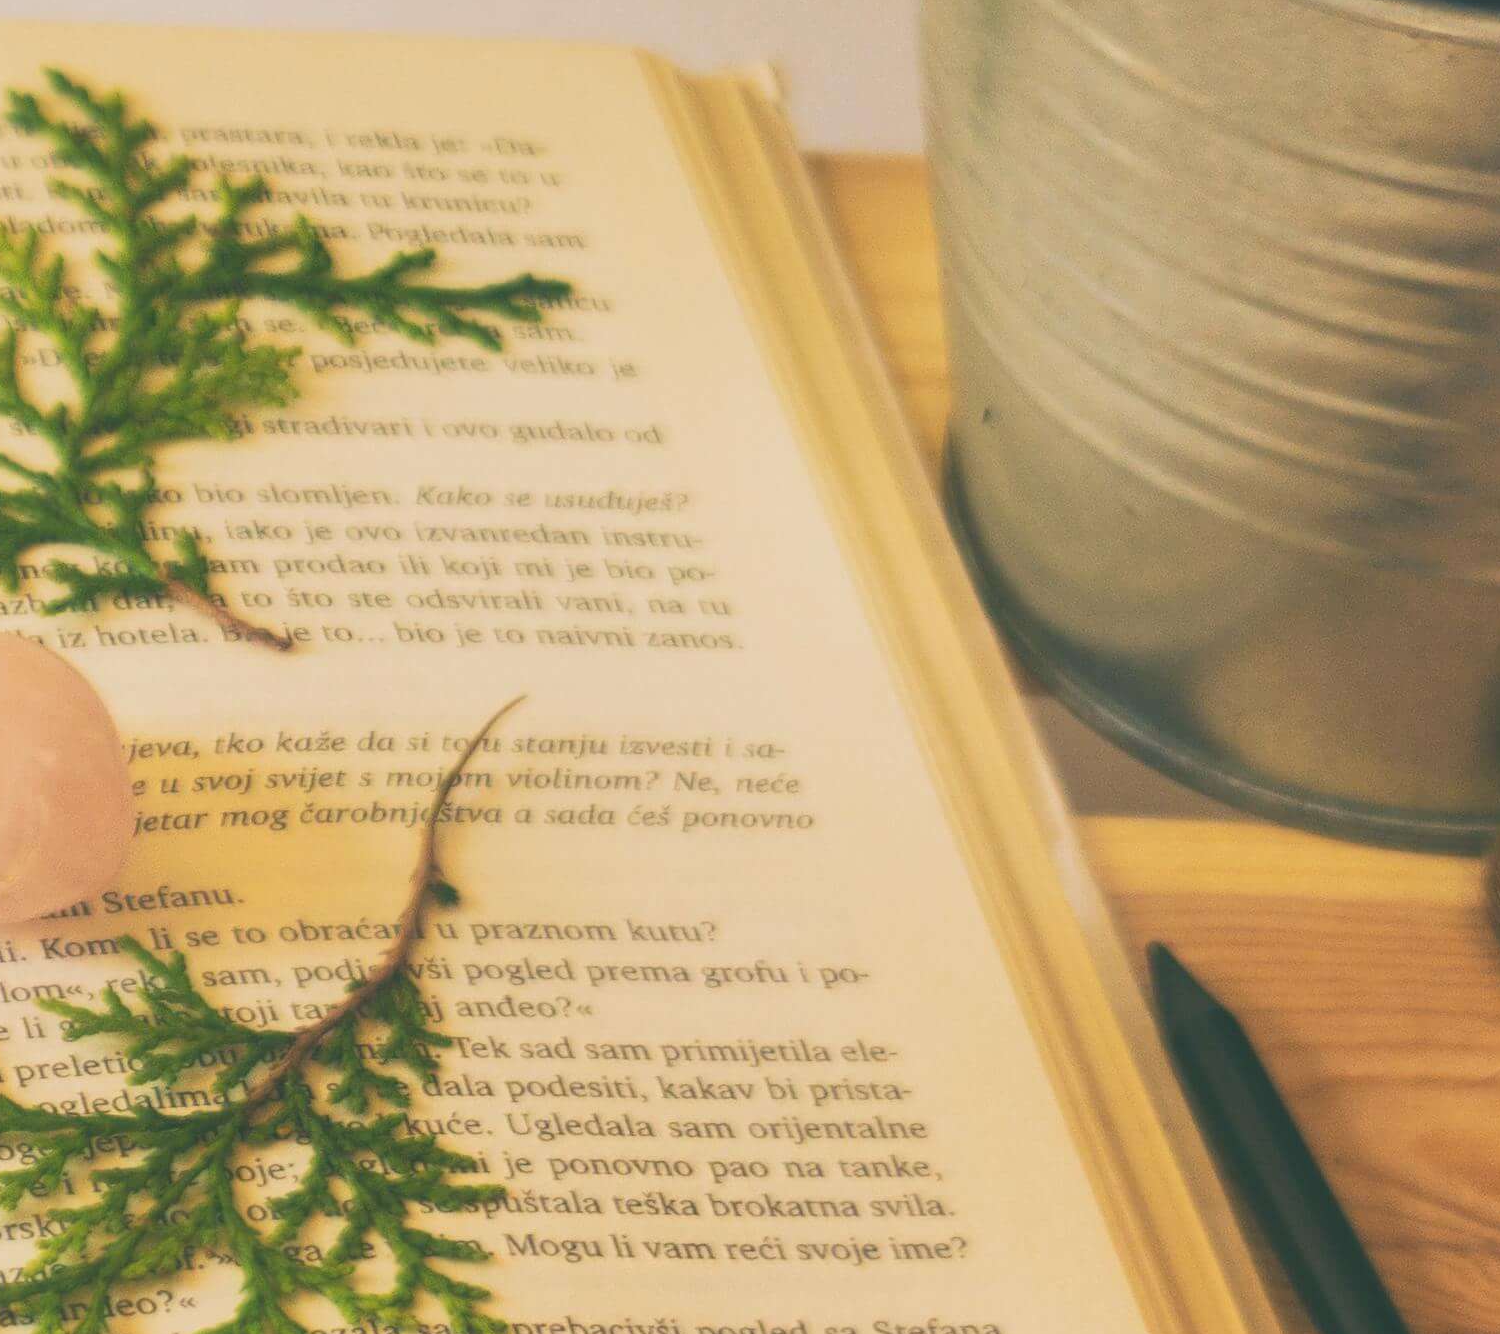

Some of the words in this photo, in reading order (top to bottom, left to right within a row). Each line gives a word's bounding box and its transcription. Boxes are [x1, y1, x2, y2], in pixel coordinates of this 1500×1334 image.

[193, 484, 246, 503] bio
[257, 484, 400, 509] slomljen.
[416, 485, 494, 507] Kako
[502, 490, 533, 509] se
[417, 1062, 495, 1097] dala
[505, 1075, 648, 1103] podesiti,
[657, 1076, 754, 1100] kakav
[765, 1077, 799, 1100] bi
[809, 1082, 912, 1107] prista-
